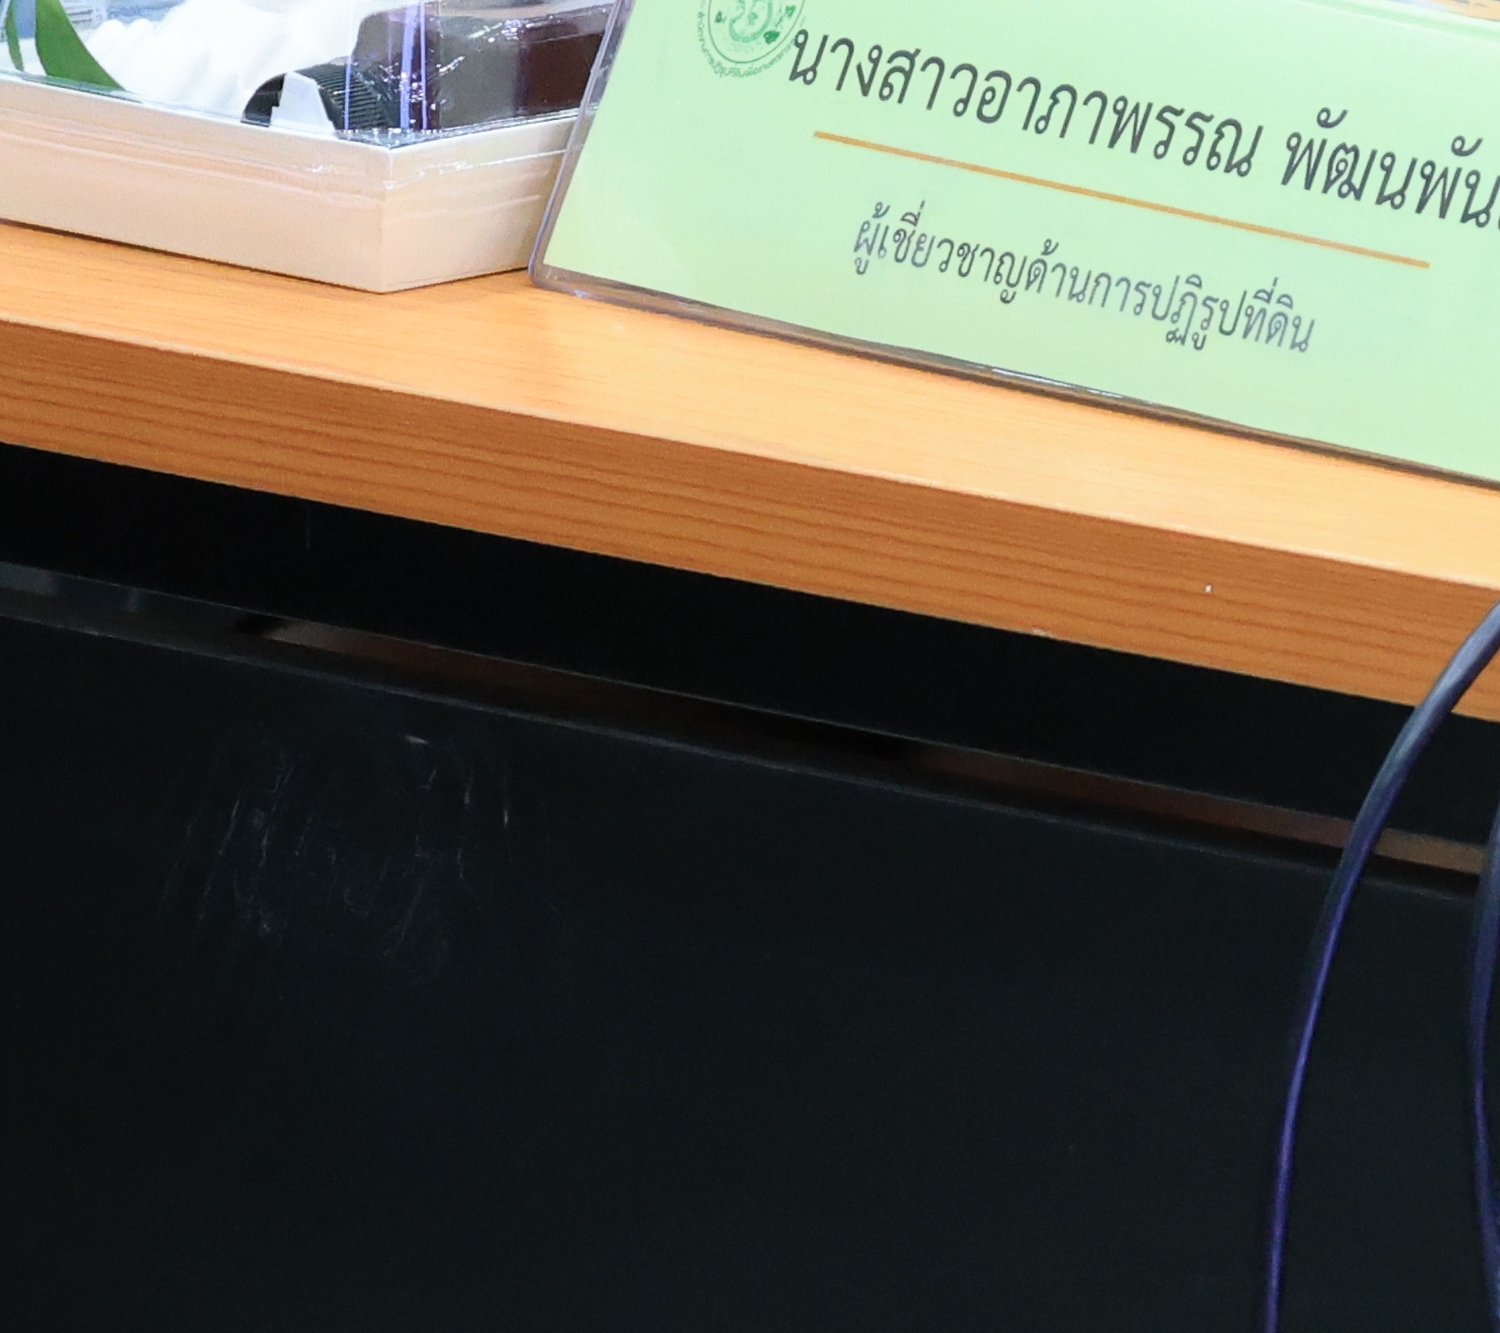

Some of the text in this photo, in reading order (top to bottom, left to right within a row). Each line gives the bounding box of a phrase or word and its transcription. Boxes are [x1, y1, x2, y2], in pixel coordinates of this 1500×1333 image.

[784, 9, 1263, 177] นางสาวอาภาพรรณ
[853, 202, 1315, 354] ผู้เชี่ยวชาญด้านการปฏิรูปที่ดิน
